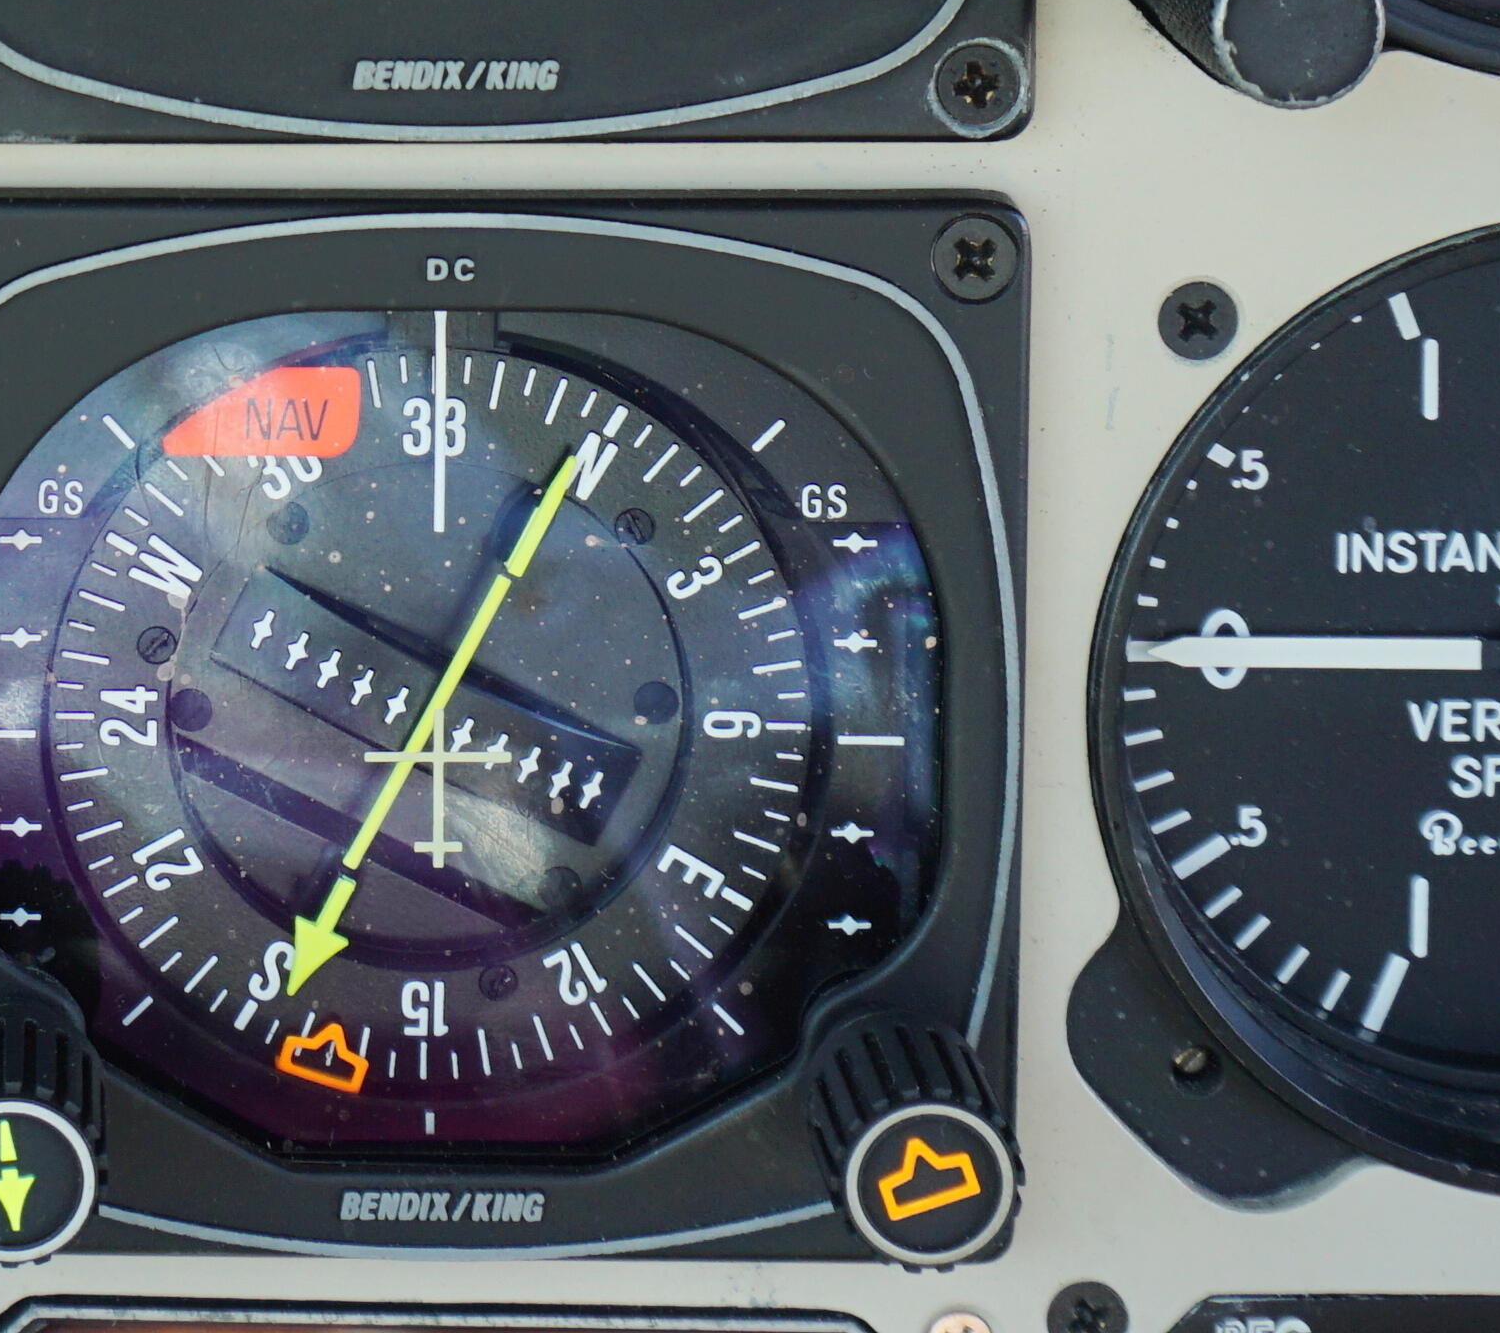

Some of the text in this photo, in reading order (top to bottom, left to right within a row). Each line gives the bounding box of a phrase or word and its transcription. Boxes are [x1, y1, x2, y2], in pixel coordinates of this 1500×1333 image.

[351, 59, 560, 95] BENDIX/KING
[426, 257, 476, 283] DC
[243, 396, 330, 444] NAV
[402, 397, 468, 456] 33
[569, 430, 619, 503] N
[37, 479, 84, 516] GS
[800, 482, 848, 519] GS
[131, 543, 201, 599] W
[666, 553, 720, 602] 3
[98, 685, 160, 746] 24
[143, 829, 200, 890] 21
[661, 844, 727, 901] E
[544, 941, 607, 1005] 12
[401, 979, 450, 1035] 15
[340, 1190, 545, 1223] BENDIX/KING
